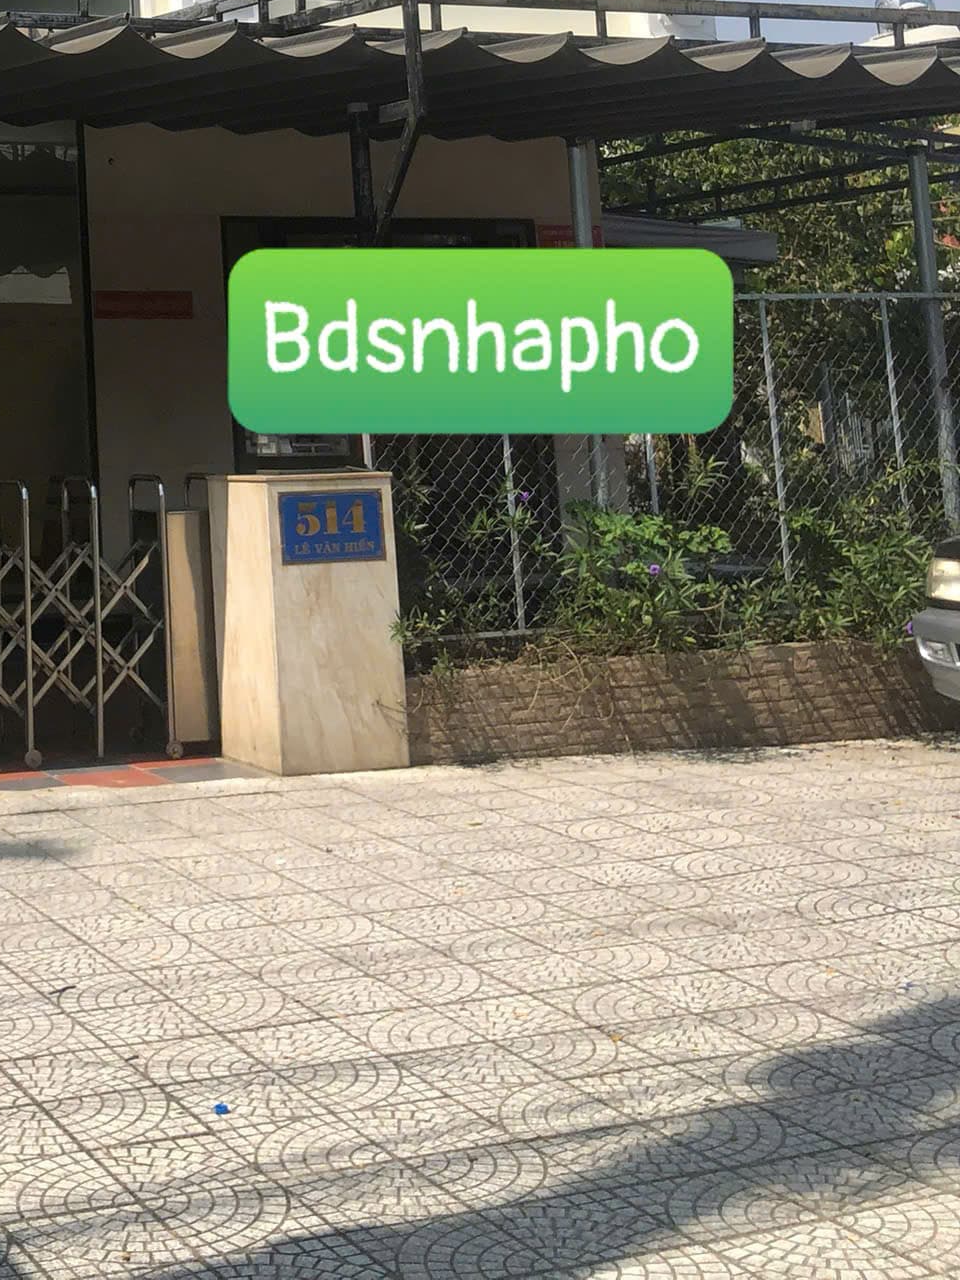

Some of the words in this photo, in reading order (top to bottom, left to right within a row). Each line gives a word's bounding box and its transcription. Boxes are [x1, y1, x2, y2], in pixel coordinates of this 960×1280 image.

[296, 500, 366, 536] 514
[295, 542, 311, 554] LÊ
[315, 541, 341, 554] VĂN
